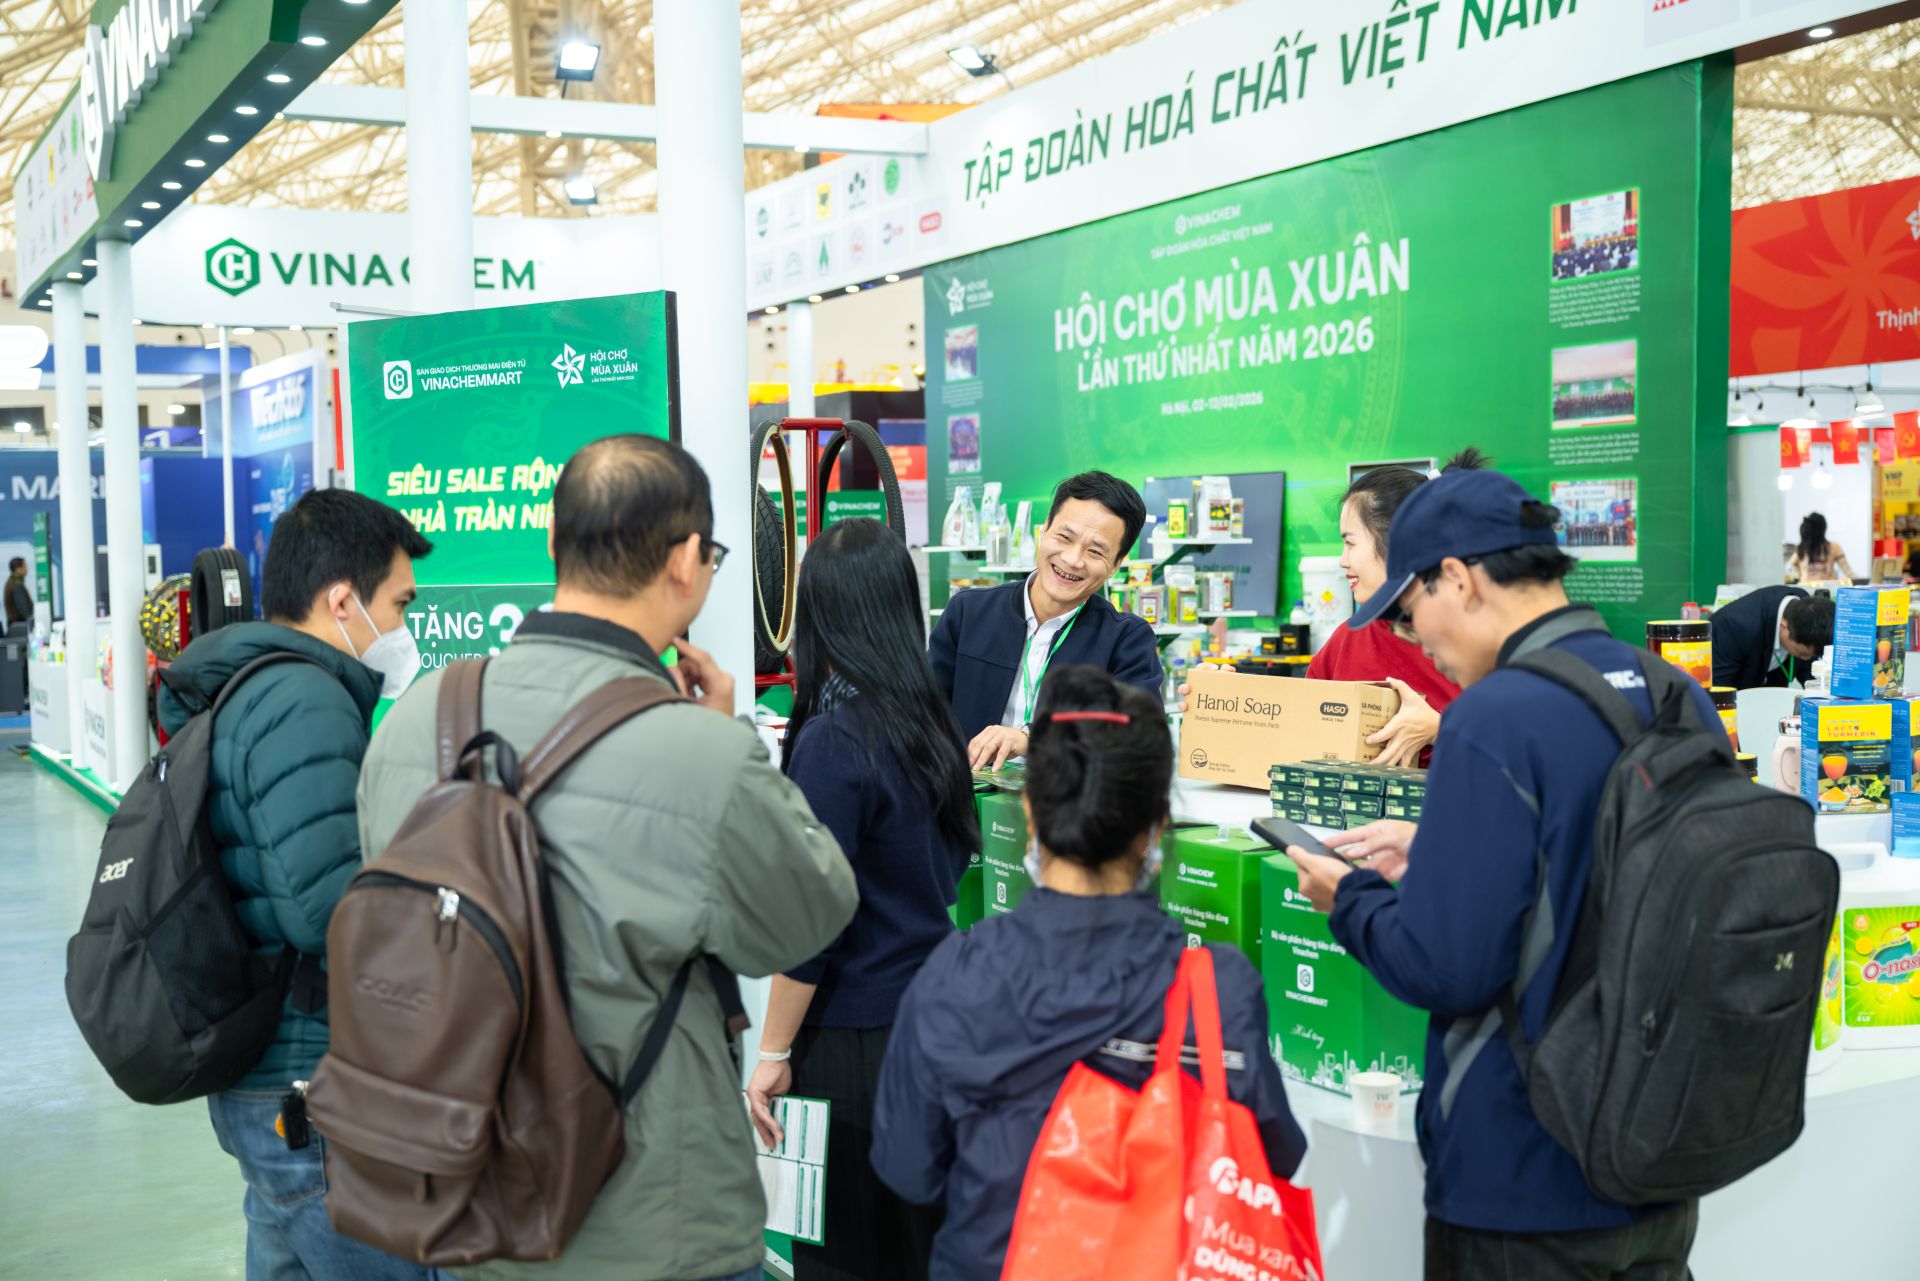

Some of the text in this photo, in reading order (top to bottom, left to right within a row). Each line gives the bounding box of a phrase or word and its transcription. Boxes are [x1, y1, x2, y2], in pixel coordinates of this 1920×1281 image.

[964, 141, 1013, 208] TẬP
[1025, 109, 1112, 182] ĐOÀN
[1123, 72, 1196, 152] HOÁ
[1211, 30, 1317, 124] CHẤT
[1339, 1, 1439, 89] VIỆT
[270, 252, 536, 290] VINAEM
[1054, 231, 1410, 360] HỘI CHỢ MÙA XUÂN
[1876, 307, 1920, 331] Thịnh
[590, 347, 628, 364] HỘI CHỢ
[1078, 316, 1375, 392] LẦN THỨ NHẤT NĂM 2026
[421, 371, 522, 391] VINACHEMMART
[591, 361, 638, 376] MÙA XUÂN
[387, 463, 441, 496] SIÊU
[446, 466, 506, 494] SALE
[454, 498, 516, 532] TRÀN
[408, 604, 484, 648] TẶNG
[1197, 693, 1282, 720] Hanoi Soap
[1324, 705, 1346, 714] HASO
[100, 857, 135, 883] acer
[1292, 946, 1319, 959] Vinachem
[1285, 990, 1328, 1007] VINACHEMMART
[1202, 1216, 1255, 1256] Mua
